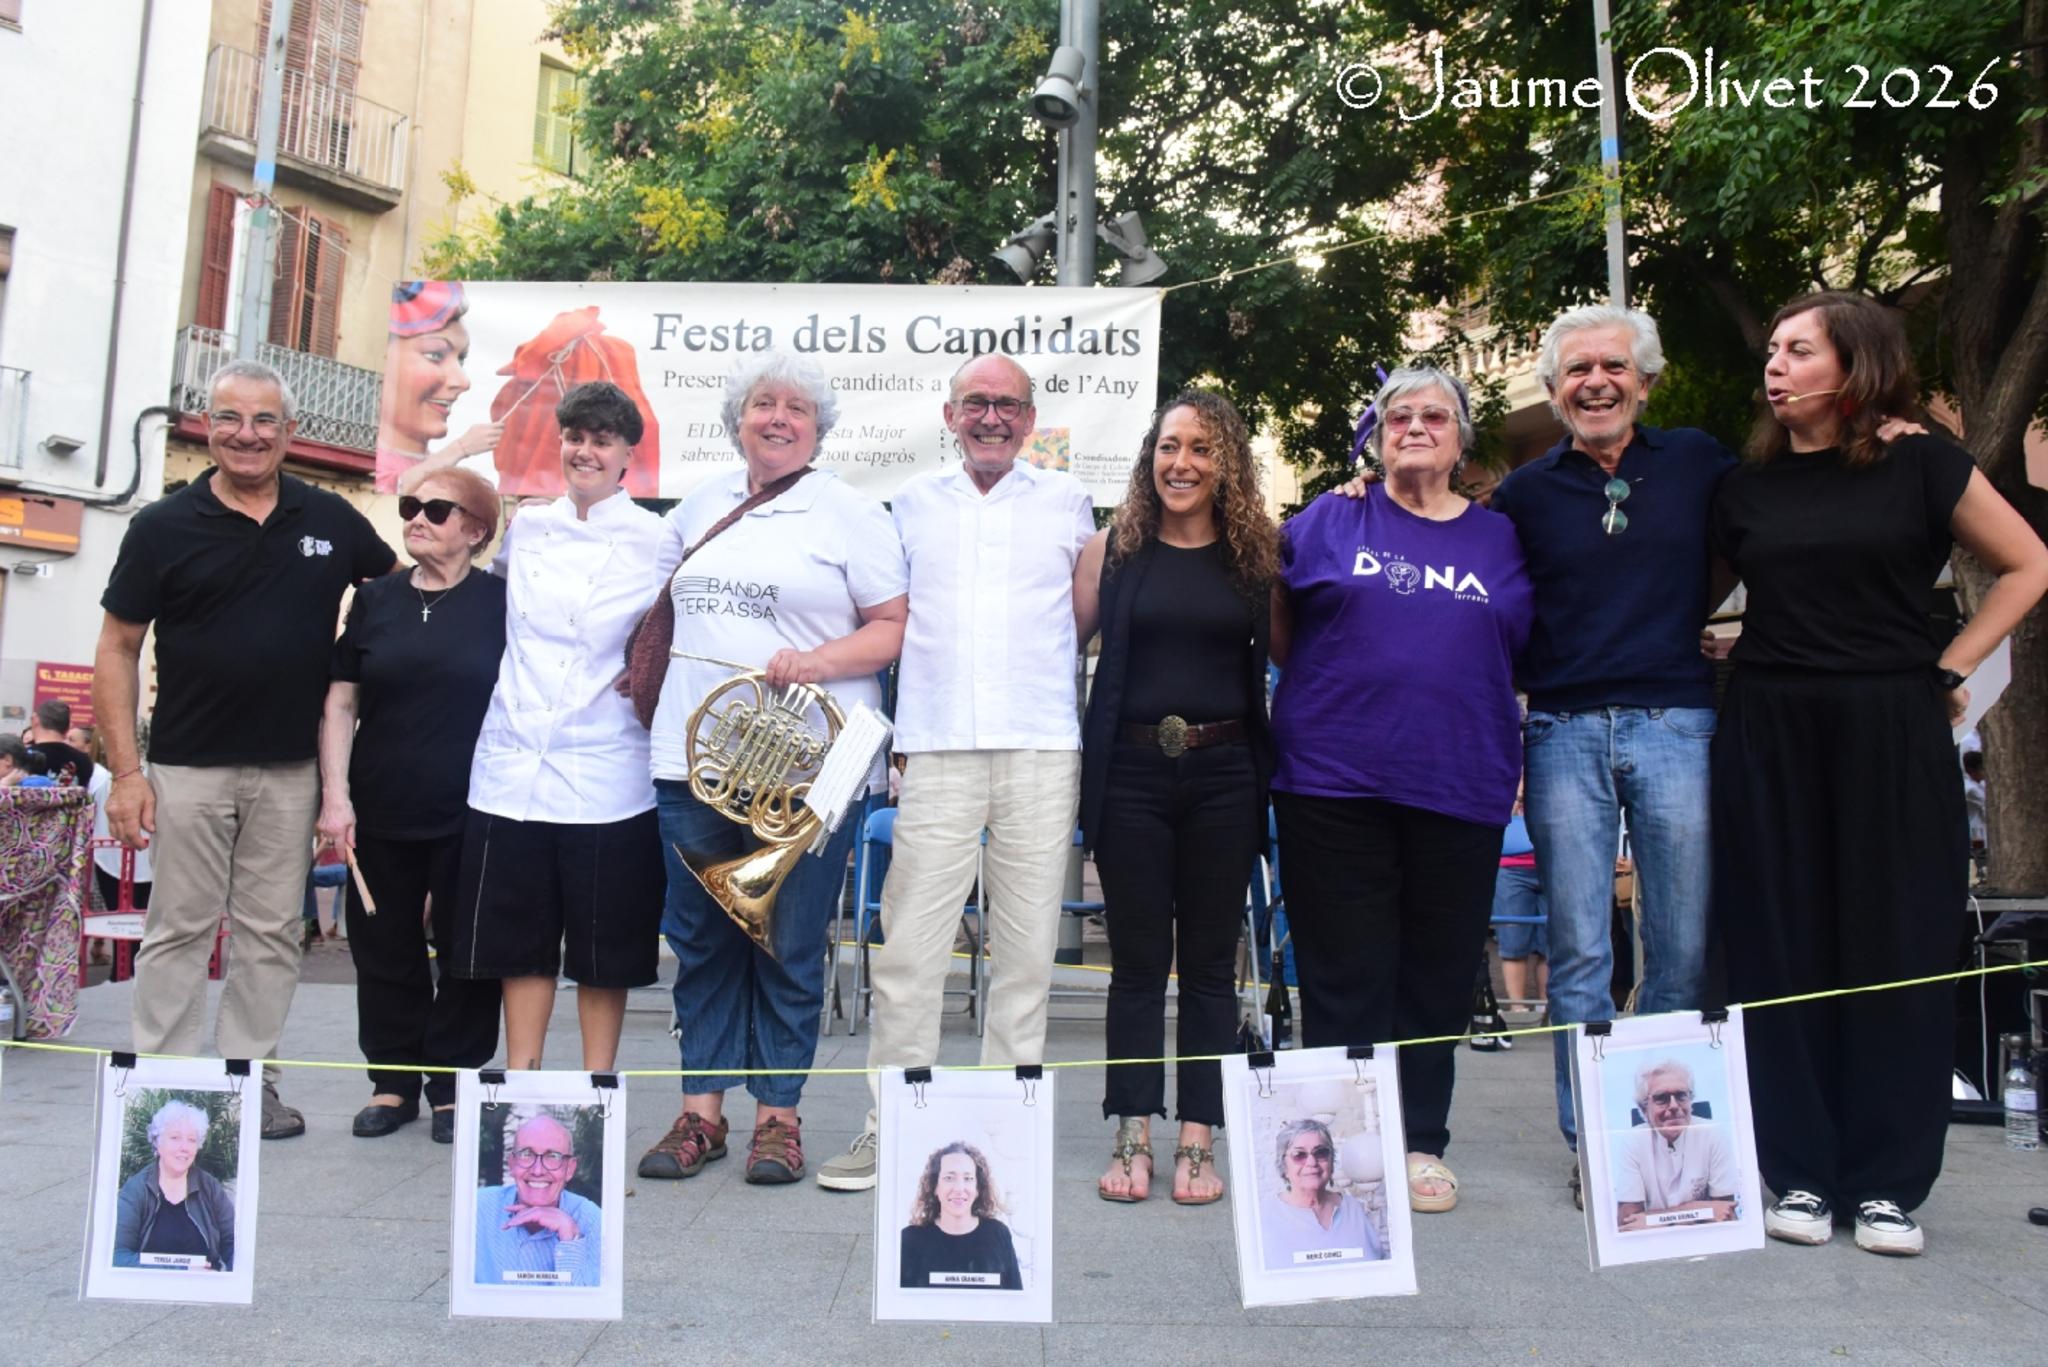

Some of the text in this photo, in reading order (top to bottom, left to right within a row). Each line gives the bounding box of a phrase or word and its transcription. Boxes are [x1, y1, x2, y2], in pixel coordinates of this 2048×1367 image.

[650, 312, 774, 353] Festa
[792, 314, 887, 354] dels
[664, 370, 942, 392] Presen candidats a
[1045, 374, 1069, 393] de
[858, 424, 906, 443] Major
[680, 446, 735, 462] sabrem
[855, 447, 916, 468] capgròs
[680, 597, 777, 622] TERRASSA
